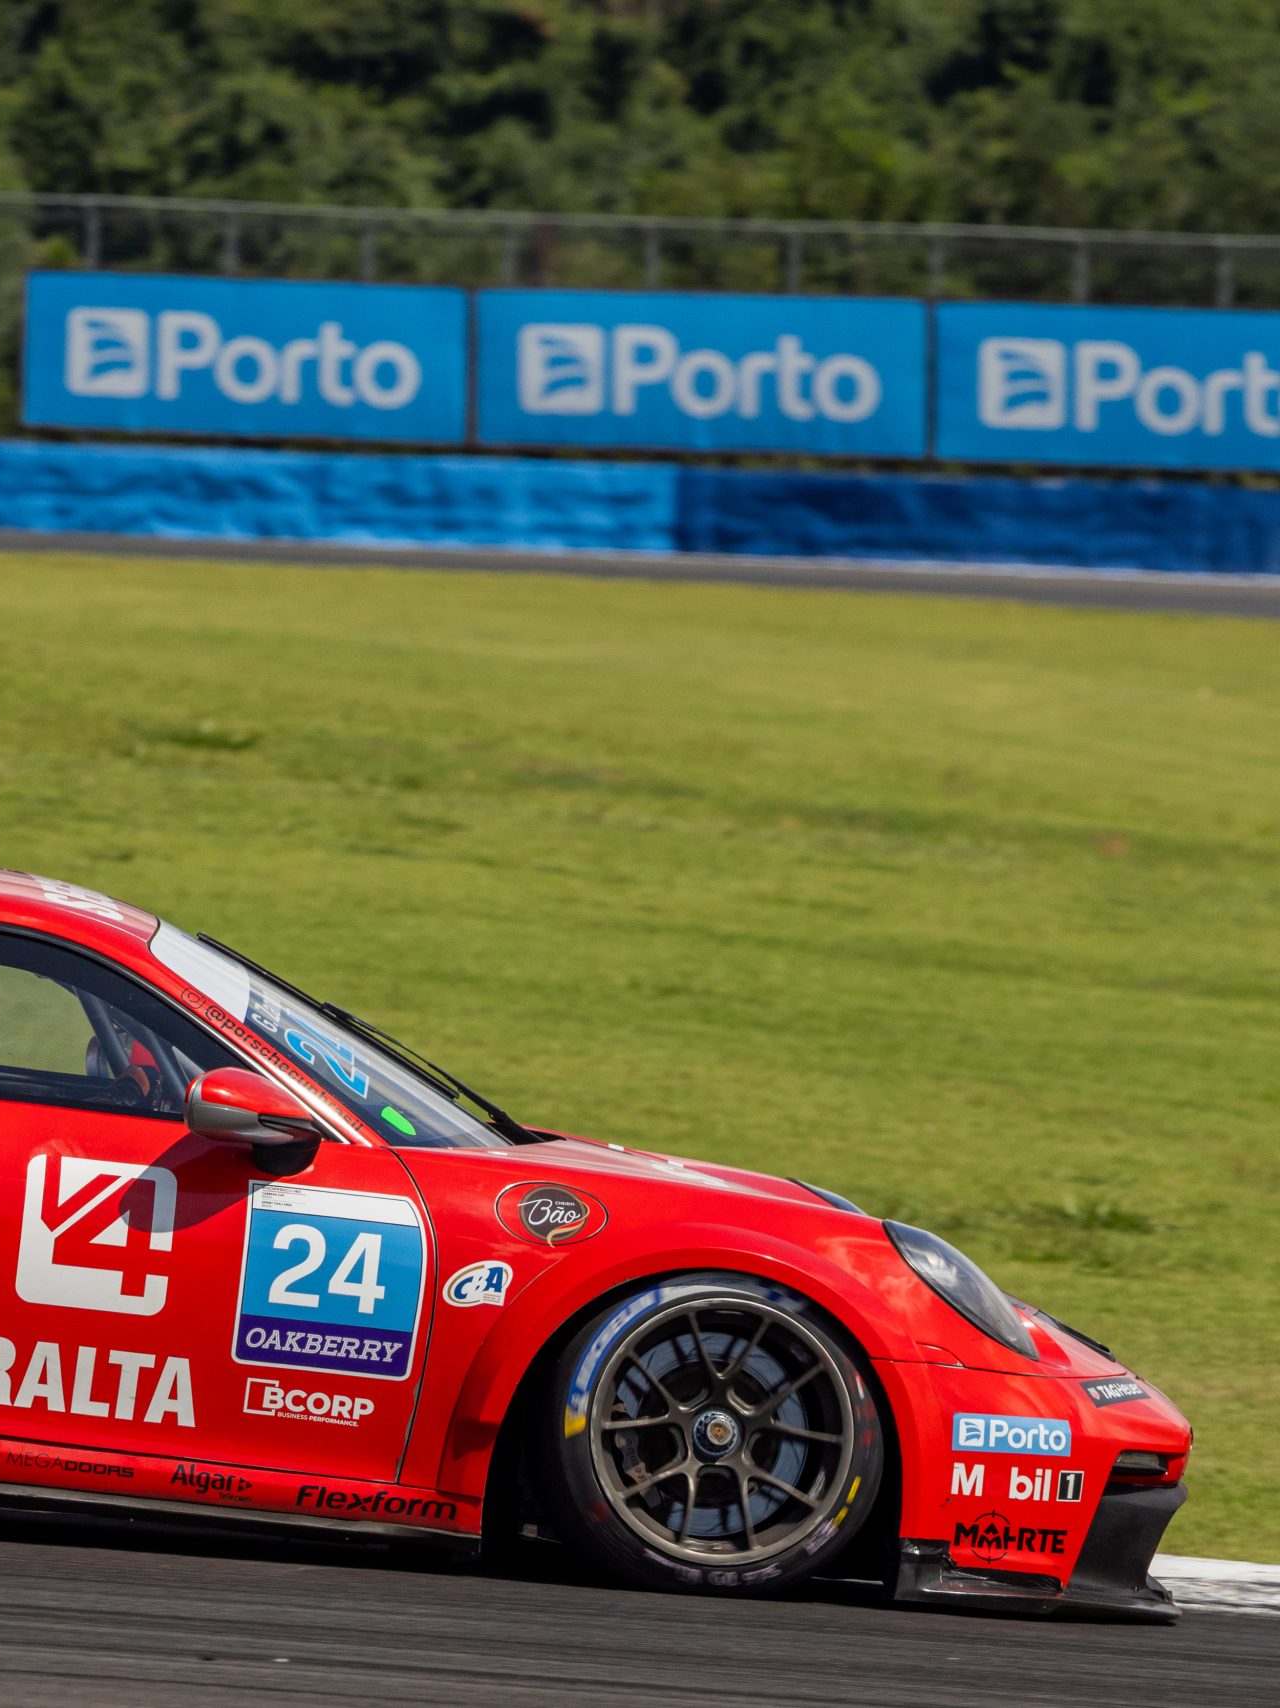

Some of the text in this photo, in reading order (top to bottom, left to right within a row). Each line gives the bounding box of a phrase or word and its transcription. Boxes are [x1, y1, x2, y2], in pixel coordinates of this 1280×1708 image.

[155, 310, 422, 409] Porto
[612, 324, 881, 423] Porto
[1074, 340, 1280, 438] Port
[517, 1199, 580, 1225] Bão
[268, 1223, 385, 1314] 24
[453, 1266, 504, 1300] CBA
[245, 1327, 403, 1363] OAKBERRY
[262, 1386, 375, 1420] BCORP
[277, 1411, 308, 1421] BUSINESS
[989, 1419, 1066, 1451] Porto
[7, 1451, 134, 1478] MEGADOORS
[171, 1464, 236, 1495] Algar
[295, 1485, 458, 1521] Flexform
